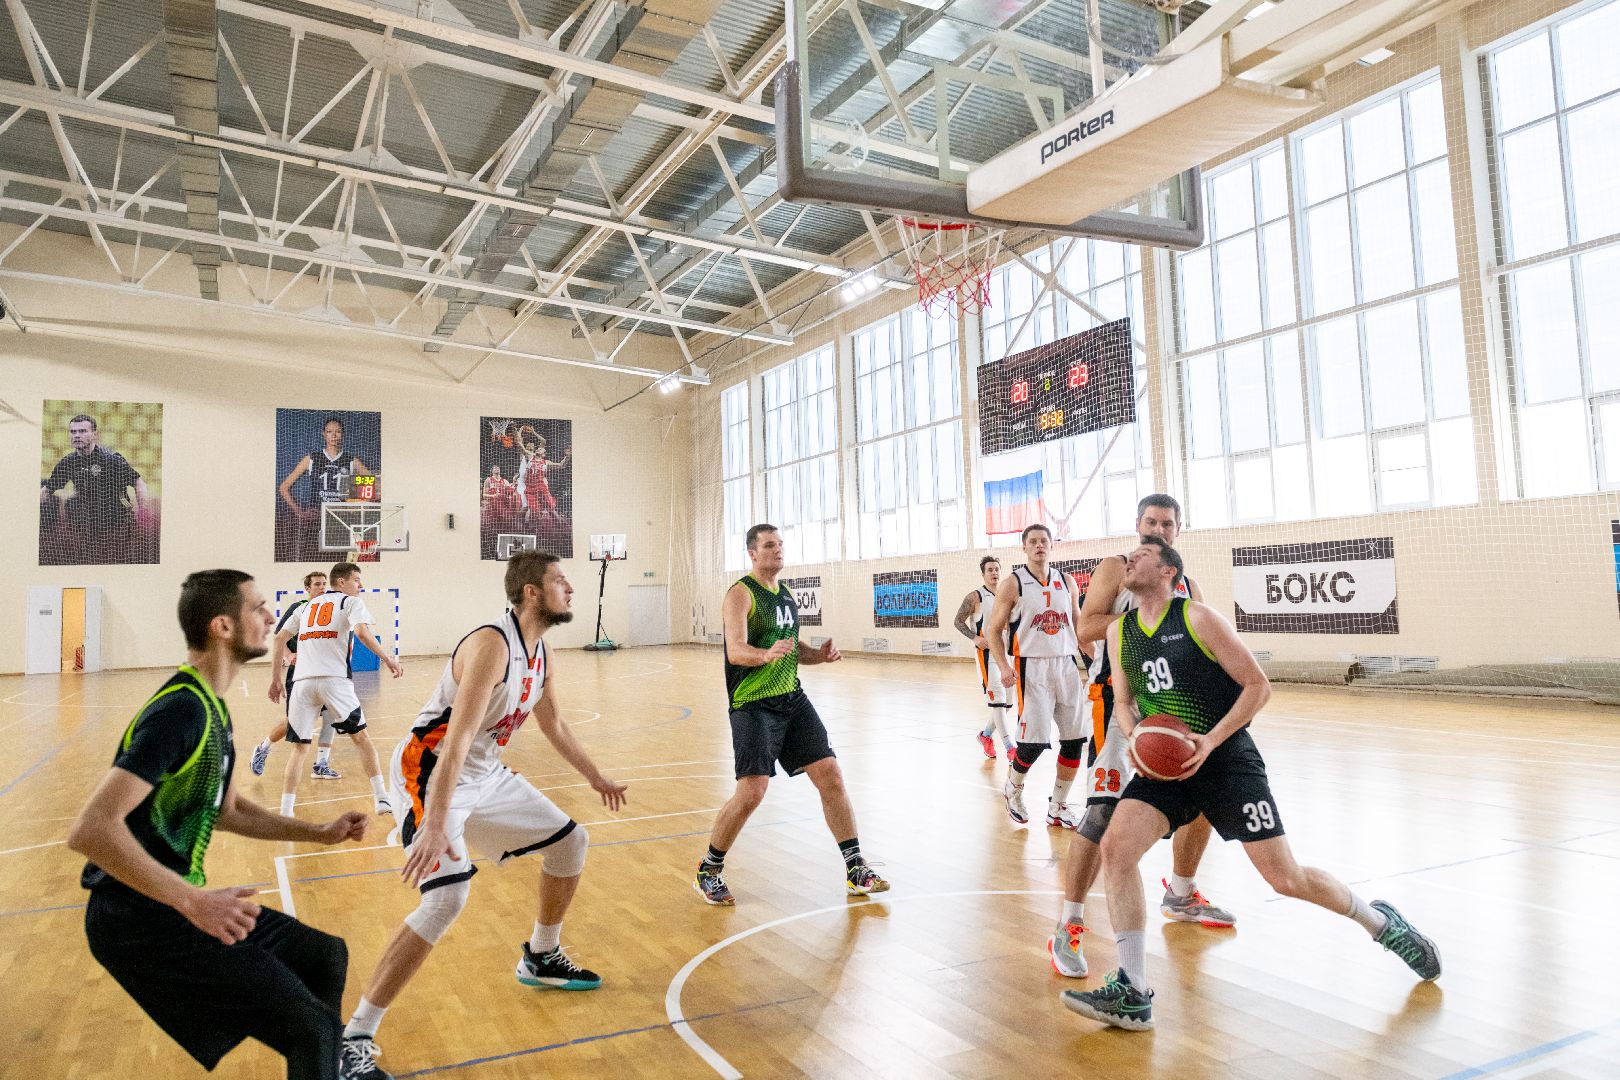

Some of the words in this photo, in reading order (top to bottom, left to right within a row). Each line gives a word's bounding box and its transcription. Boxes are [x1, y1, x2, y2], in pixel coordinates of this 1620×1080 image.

[1069, 364, 1088, 388] 23
[1012, 381, 1028, 403] 20
[1040, 409, 1064, 430] 9:32
[319, 472, 342, 491] 11
[355, 476, 375, 485] 9:32
[361, 485, 373, 499] 18
[876, 587, 934, 609] ВОЛЕЙБОЛ
[1265, 571, 1356, 603] БОКС
[1042, 591, 1051, 607] 7
[307, 602, 334, 627] 18
[776, 605, 795, 629] 44
[1142, 657, 1174, 693] 39
[1094, 767, 1121, 793] 23
[1242, 800, 1276, 833] 39
